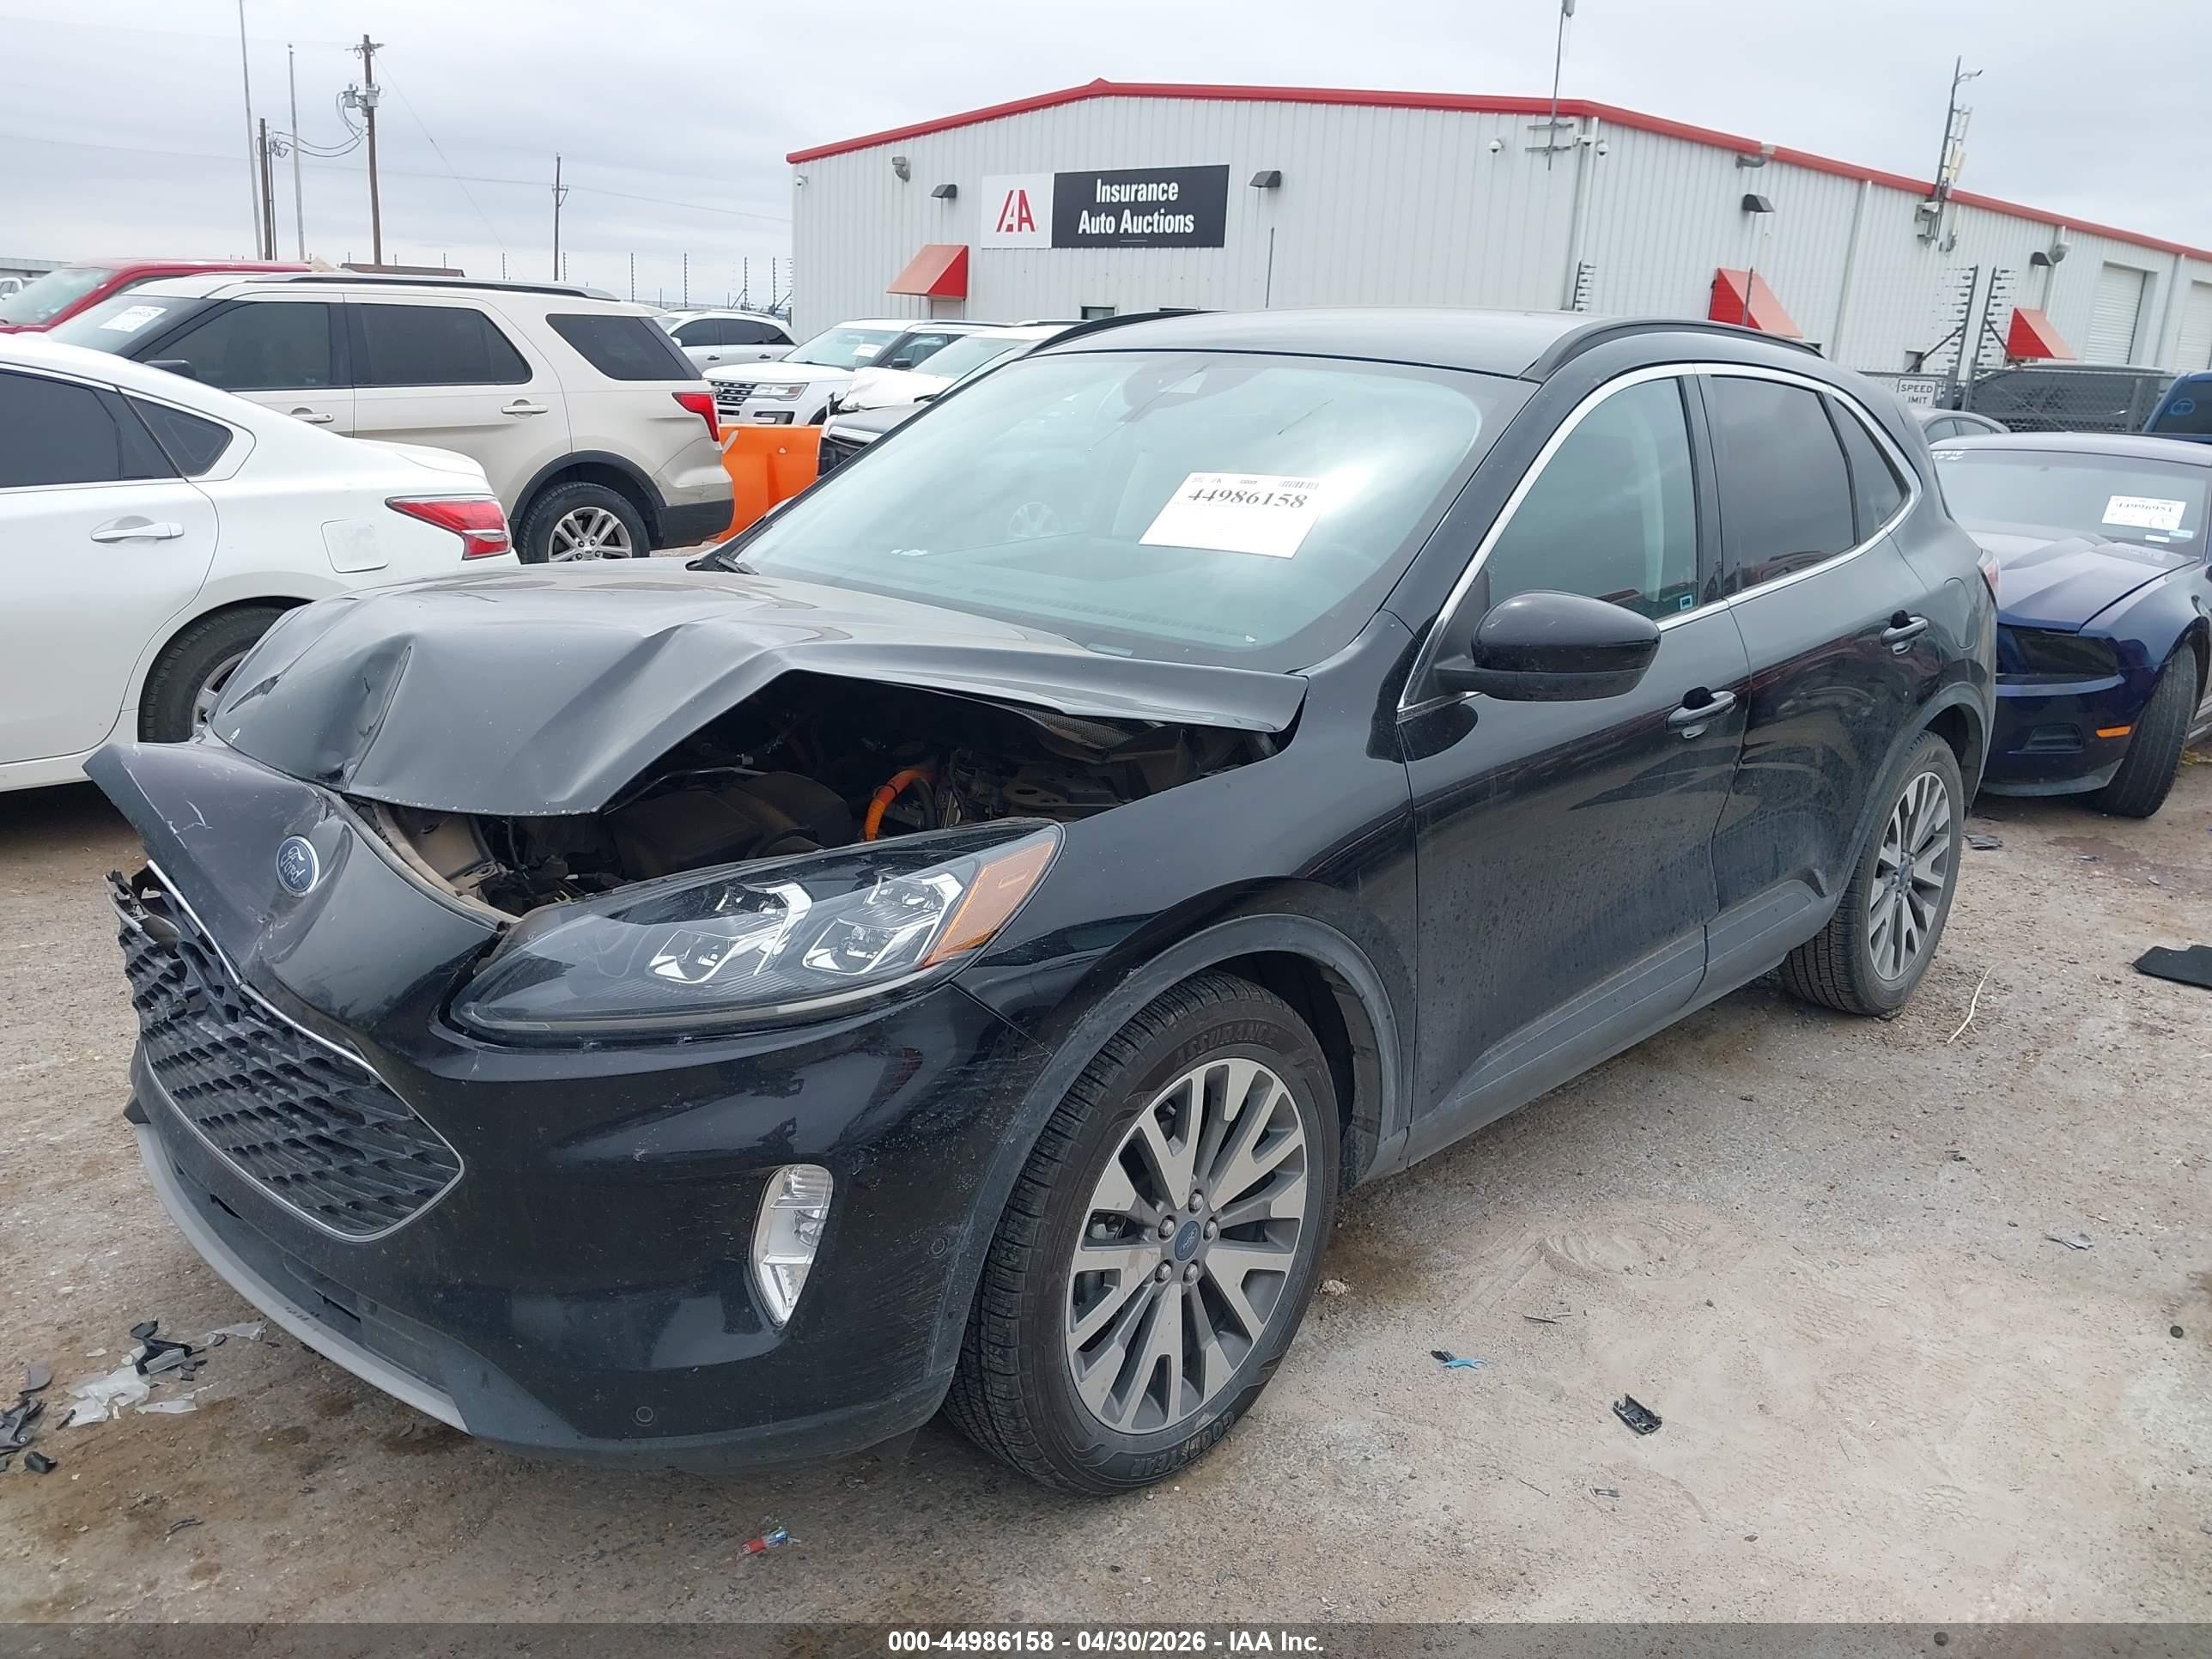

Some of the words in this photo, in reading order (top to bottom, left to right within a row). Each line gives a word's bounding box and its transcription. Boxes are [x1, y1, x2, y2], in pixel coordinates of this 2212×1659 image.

[1096, 179, 1179, 204] Insurance
[1078, 210, 1115, 234] Auto
[1119, 208, 1195, 234] Auctions
[1900, 385, 1934, 393] SPEED
[1907, 396, 1928, 404] IMIT
[1188, 489, 1308, 509] 44986158
[280, 846, 306, 884] Ford
